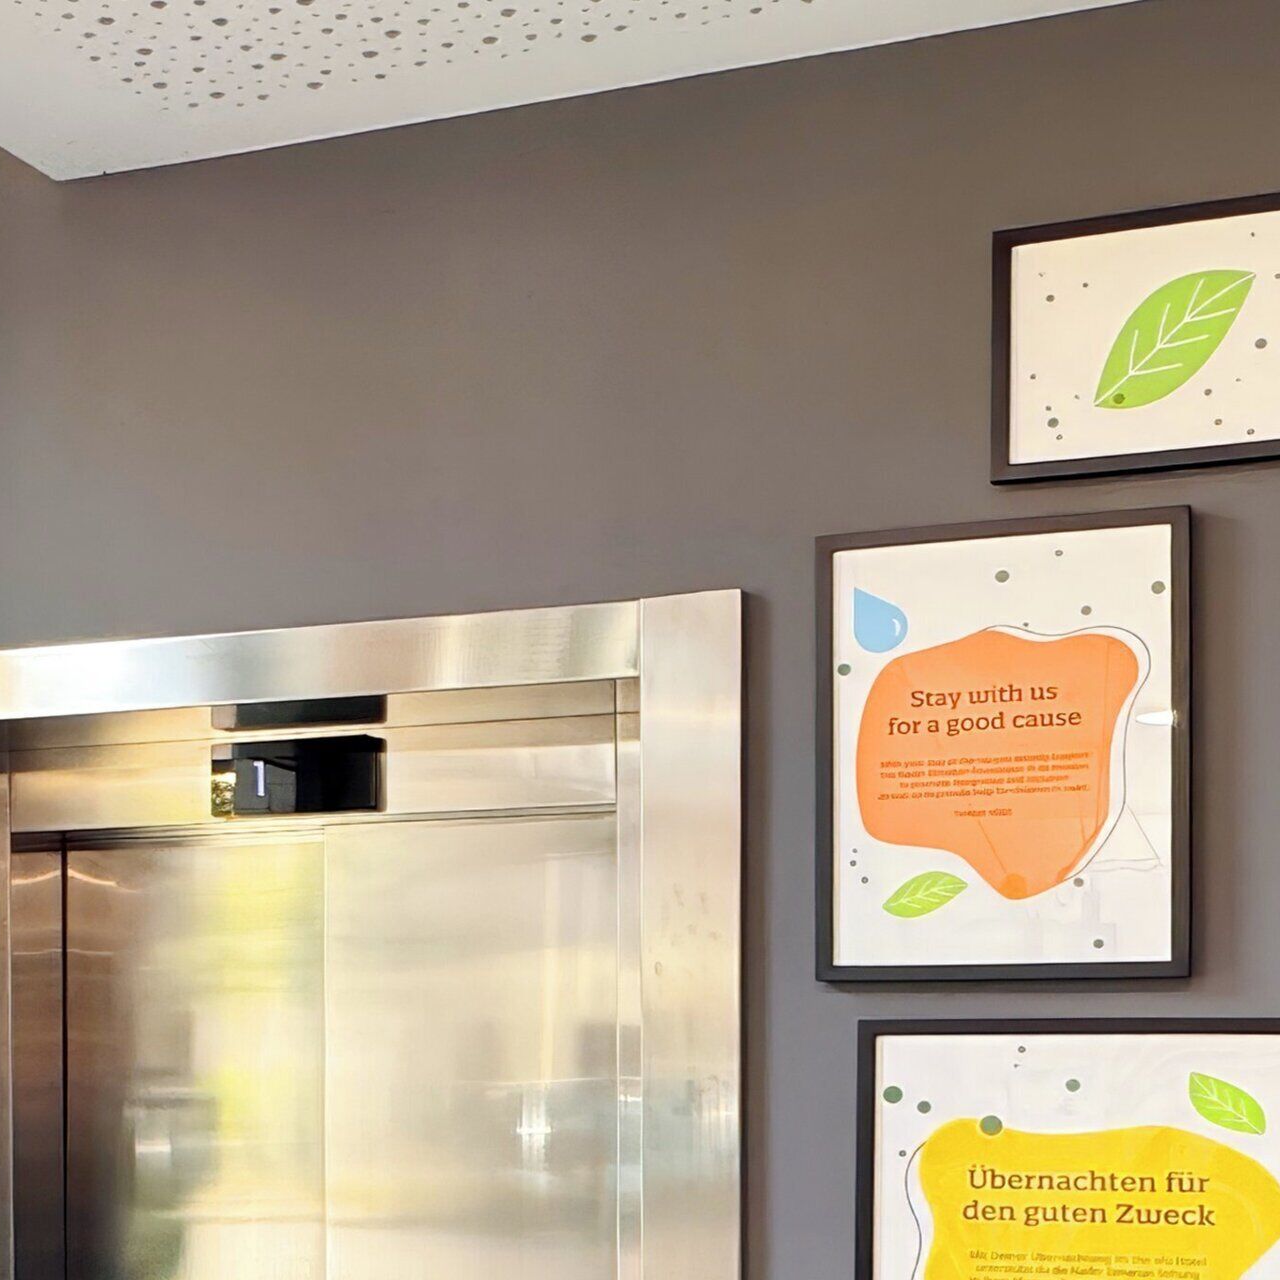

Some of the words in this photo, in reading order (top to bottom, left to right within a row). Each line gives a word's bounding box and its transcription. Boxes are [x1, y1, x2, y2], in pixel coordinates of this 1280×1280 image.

[911, 689, 961, 710] Stay
[969, 684, 1022, 704] with
[1030, 686, 1058, 701] us
[888, 717, 921, 735] for
[927, 718, 939, 733] a
[946, 711, 1005, 737] good
[1012, 711, 1081, 728] cause
[253, 760, 265, 797] 1
[968, 1163, 1157, 1193] Übernachten
[1165, 1171, 1210, 1193] für
[962, 1199, 1016, 1221] den
[1023, 1203, 1107, 1227] guten
[1115, 1203, 1216, 1226] Zweck
